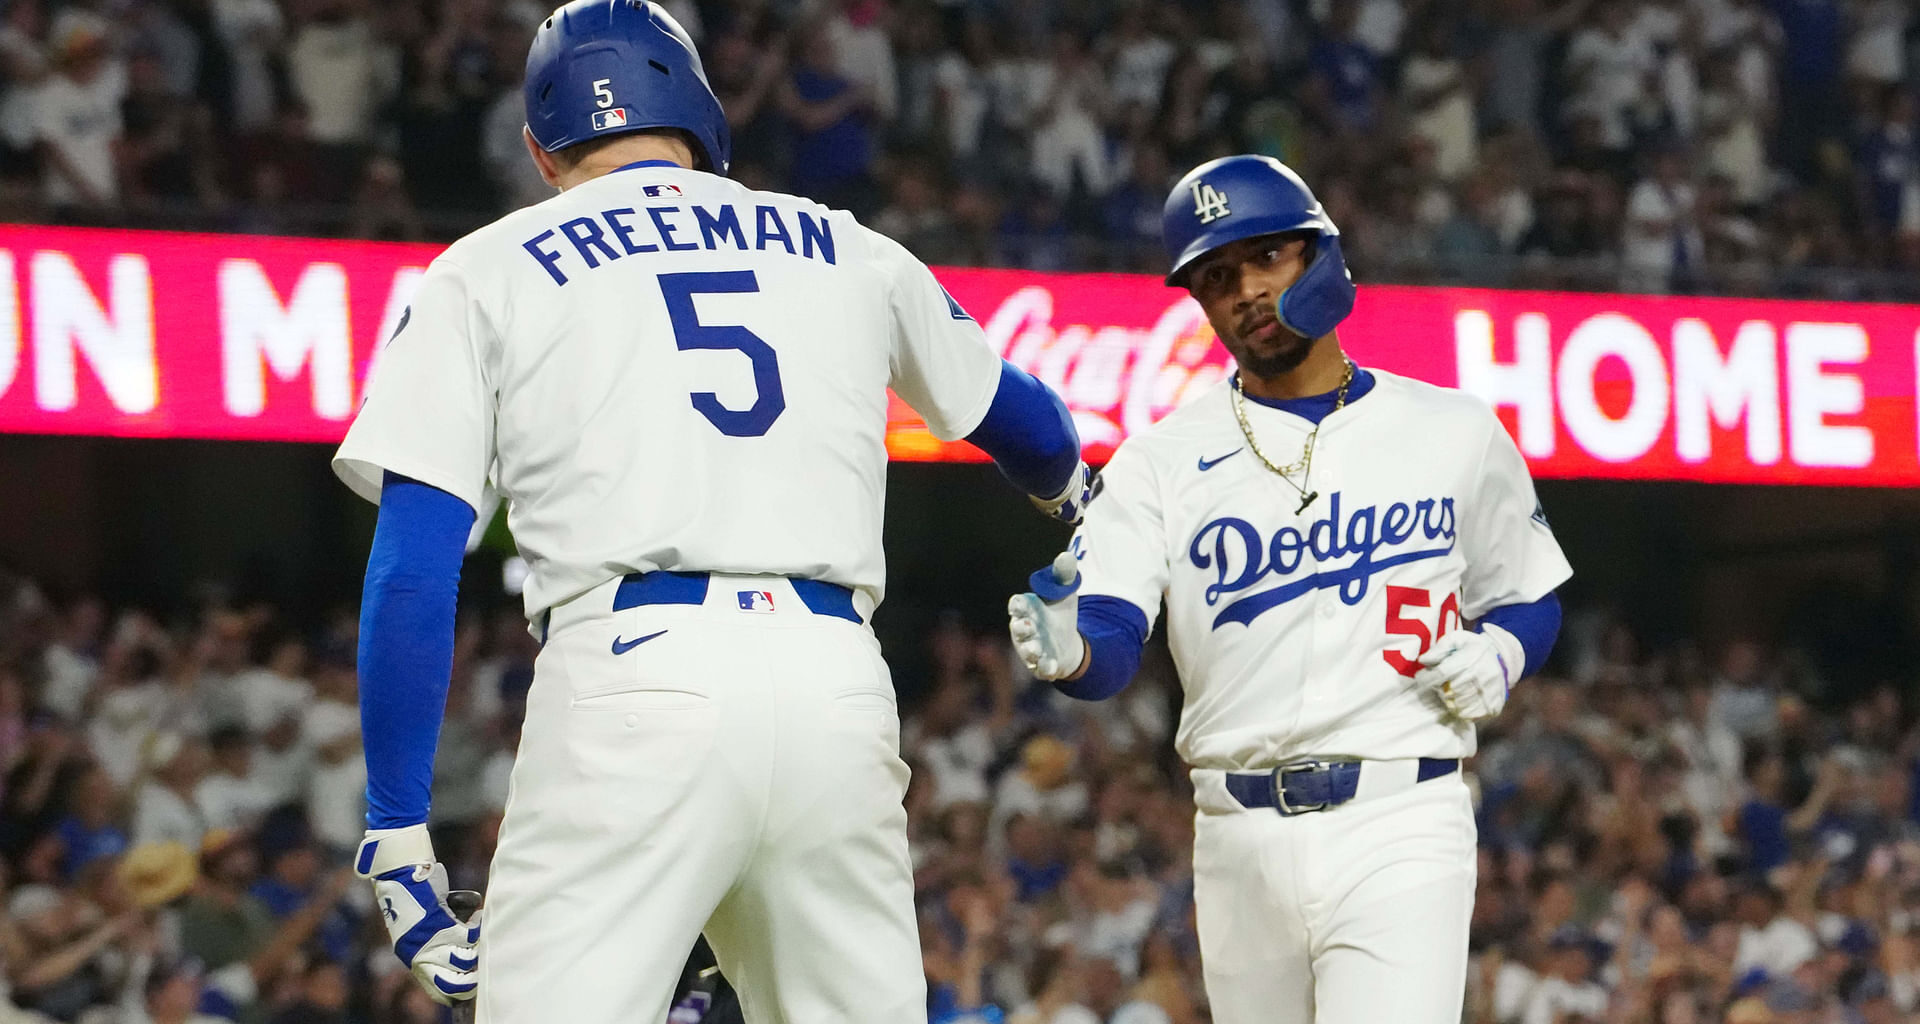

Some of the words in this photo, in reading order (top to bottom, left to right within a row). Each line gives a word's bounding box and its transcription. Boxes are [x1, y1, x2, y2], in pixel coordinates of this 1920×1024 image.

[593, 78, 614, 109] 5
[522, 204, 836, 287] FREEMAN
[1190, 180, 1231, 224] LA
[0, 248, 159, 415] N
[656, 270, 786, 438] 5
[1454, 309, 1876, 468] HOME
[1190, 491, 1456, 606] Dodgers
